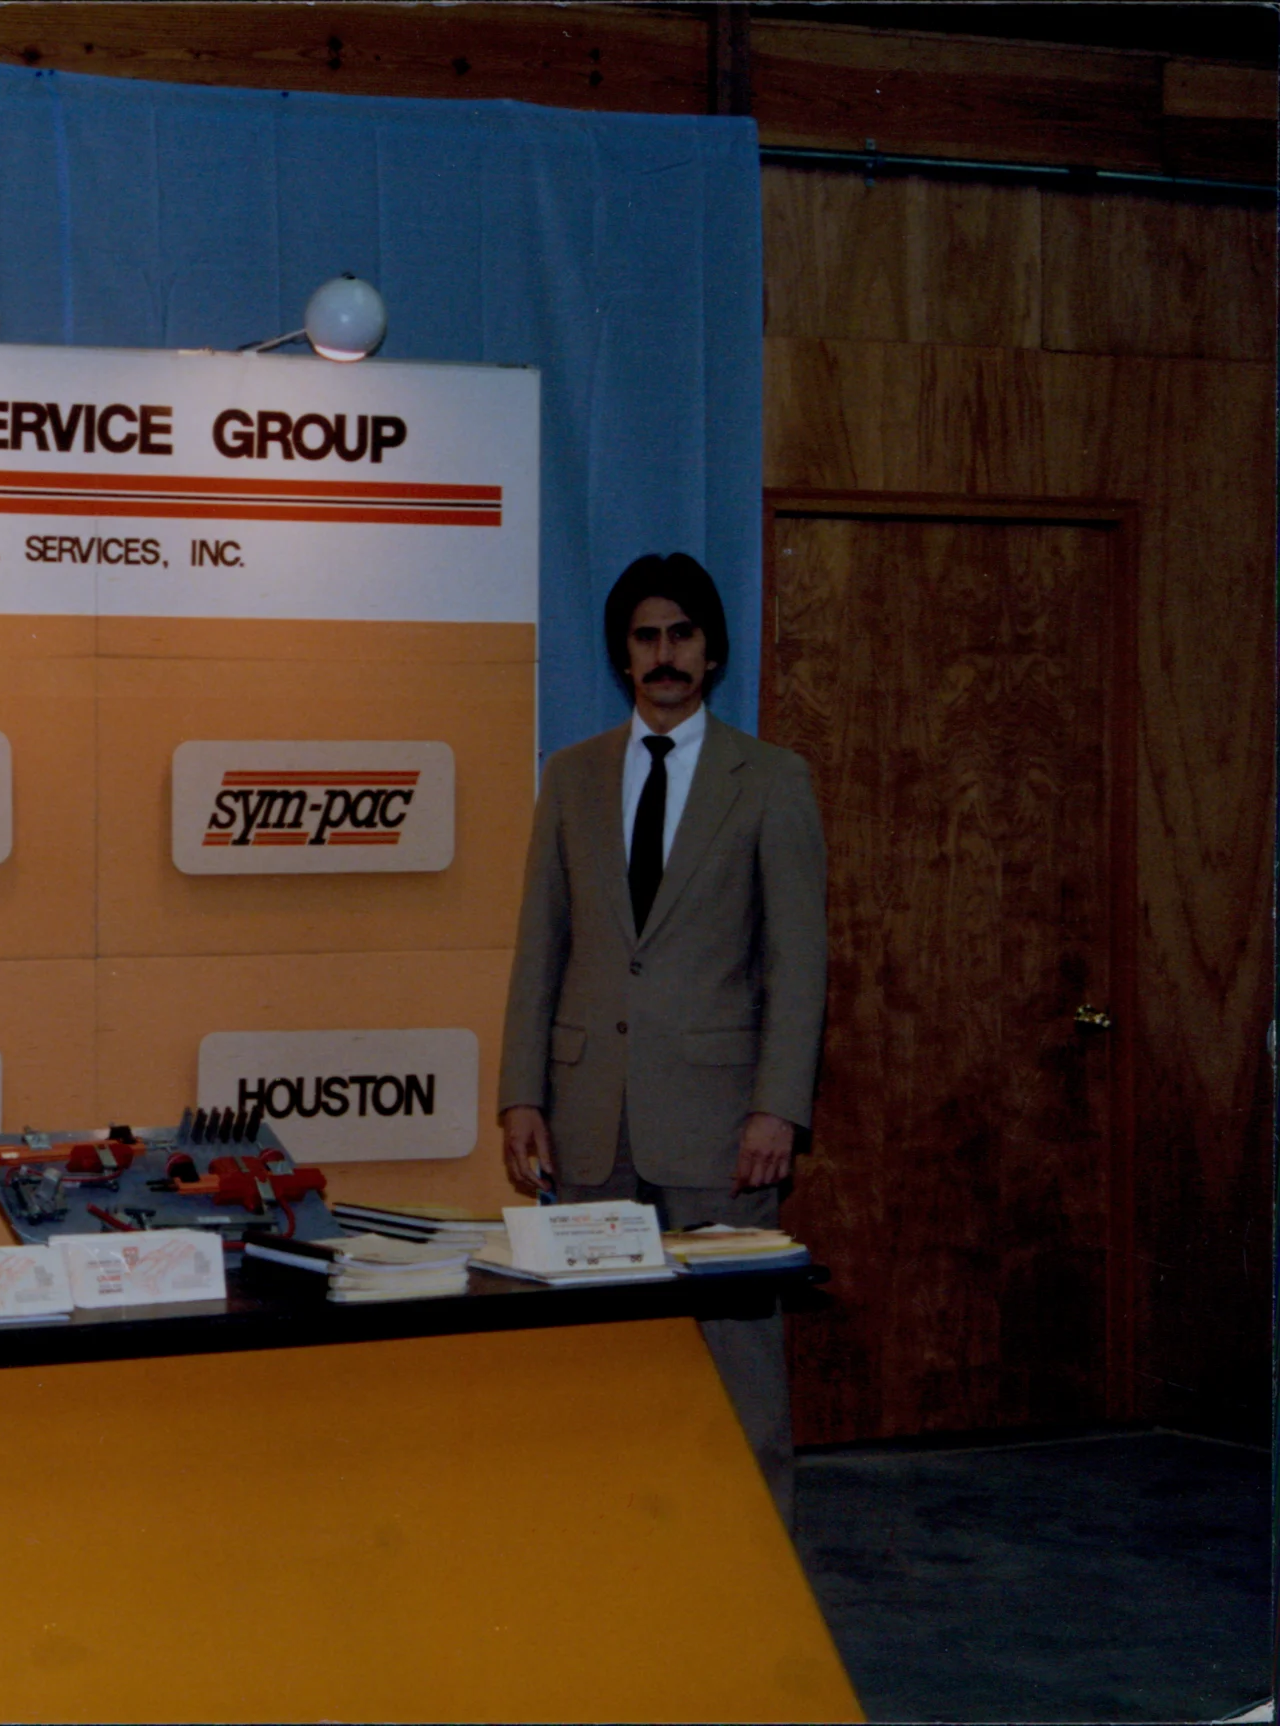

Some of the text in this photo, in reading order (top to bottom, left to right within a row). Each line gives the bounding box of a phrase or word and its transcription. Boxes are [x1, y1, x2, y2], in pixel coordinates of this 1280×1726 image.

[213, 408, 408, 464] GROUP
[24, 534, 169, 570] SERVICES,
[190, 538, 246, 568] INC.
[208, 788, 414, 846] sym-pac
[237, 1073, 436, 1121] HOUSTON
